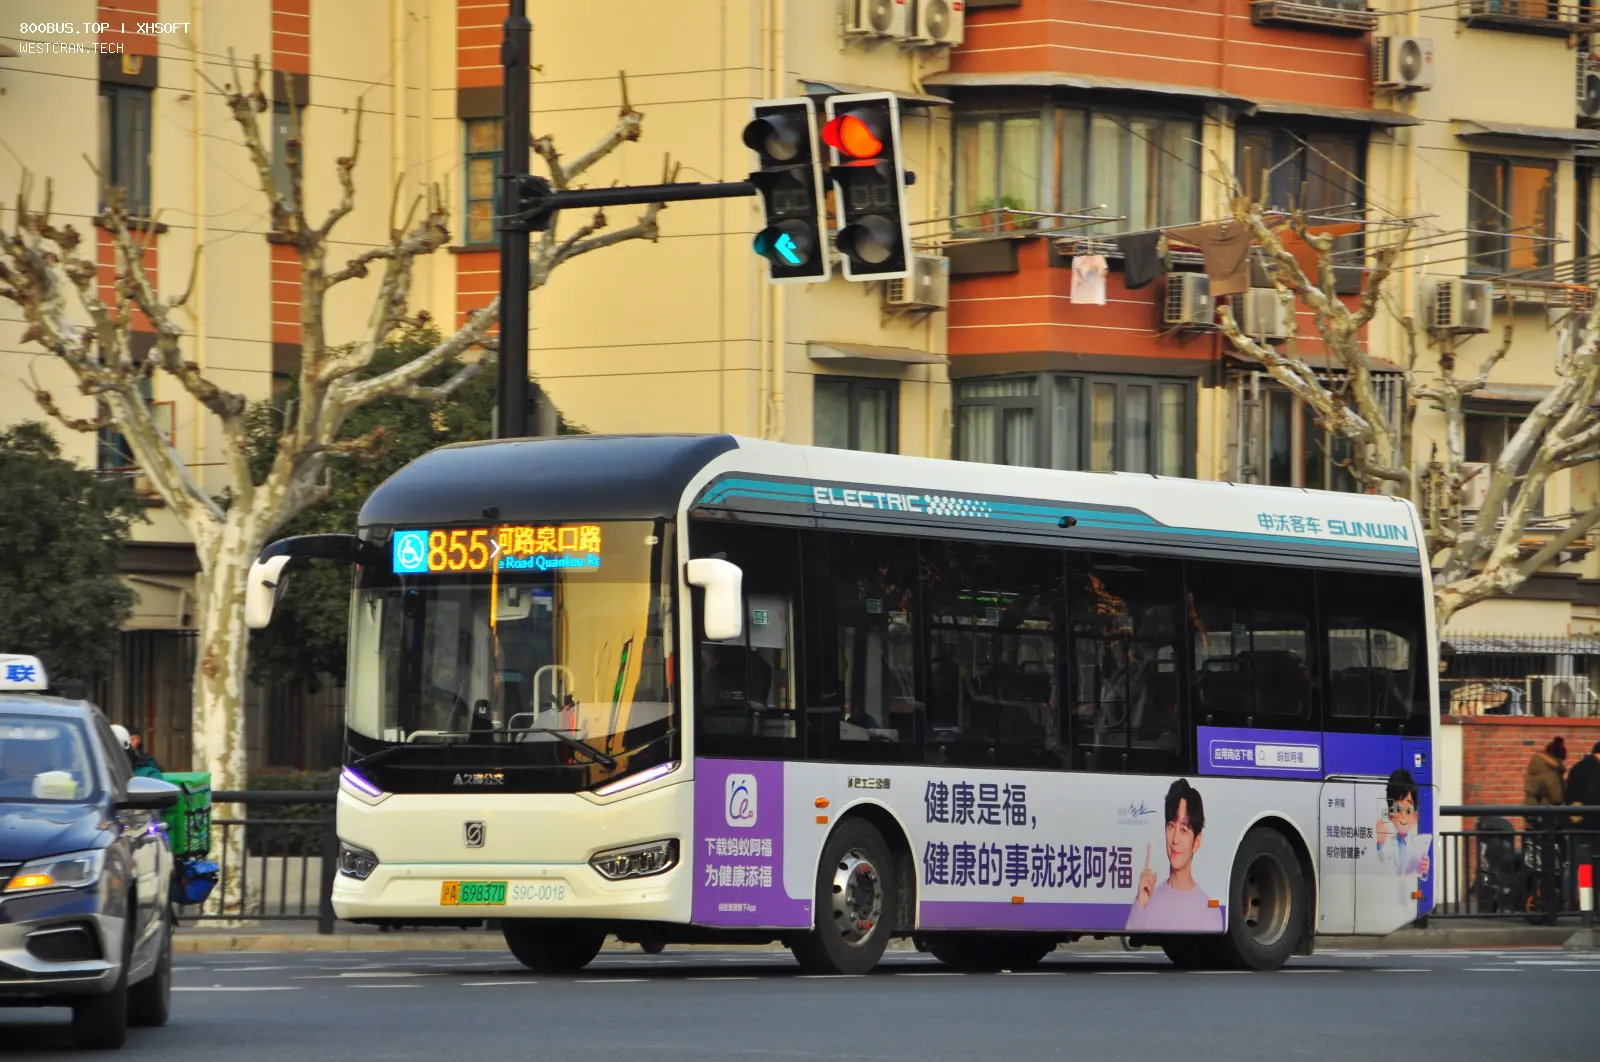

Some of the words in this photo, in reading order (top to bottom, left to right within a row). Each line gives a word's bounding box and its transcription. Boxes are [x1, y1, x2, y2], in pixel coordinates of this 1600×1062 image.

[813, 486, 923, 512] ELECTRIC
[1257, 512, 1323, 535] 申沃客车
[1327, 519, 1409, 541] SUNWIN
[427, 529, 489, 571] 855
[506, 555, 534, 569] Road
[535, 554, 585, 571] Quankou
[5, 664, 37, 683] 联
[704, 837, 772, 857] 下载蚂蚁阿福
[704, 864, 772, 888] 为健康添福
[923, 840, 1133, 889] 健康的事就找阿福
